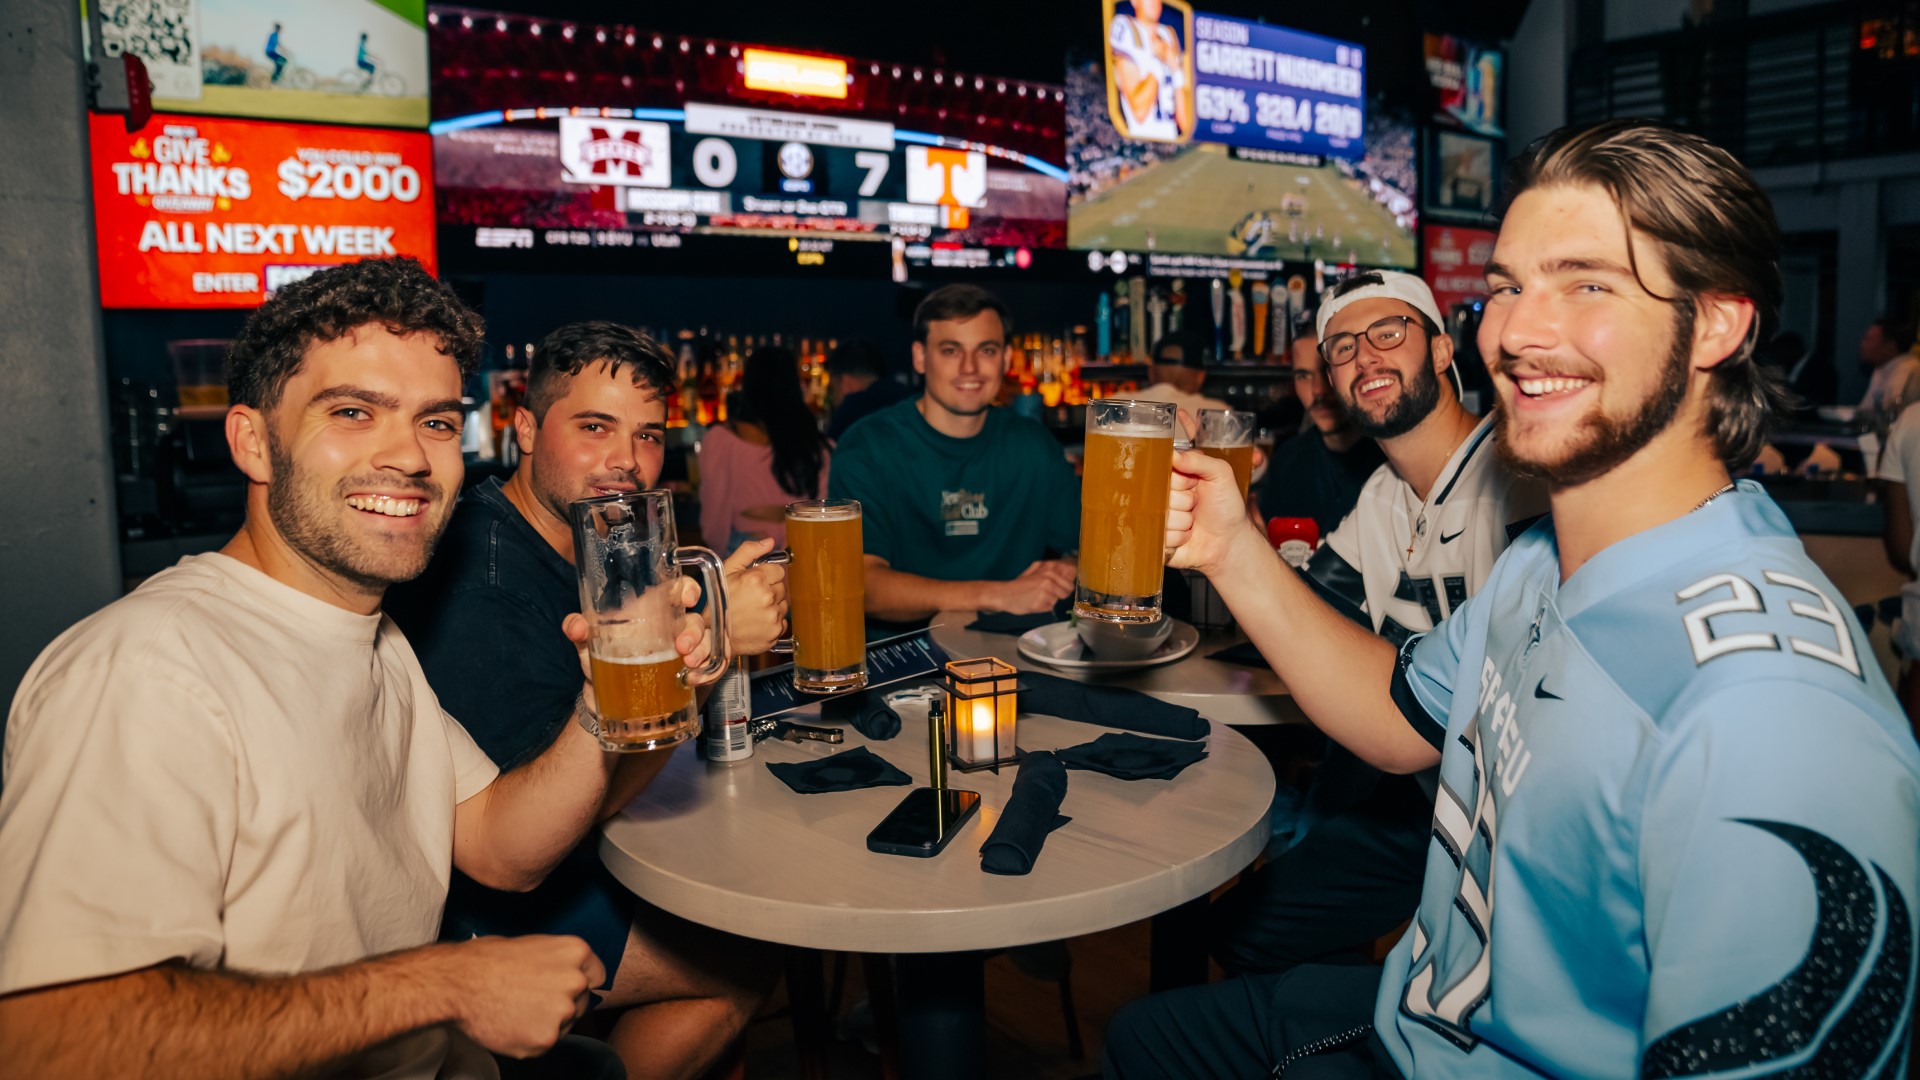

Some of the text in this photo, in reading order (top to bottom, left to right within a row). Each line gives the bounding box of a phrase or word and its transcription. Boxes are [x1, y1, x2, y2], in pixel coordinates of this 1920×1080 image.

[1196, 16, 1249, 46] SEASON
[1196, 39, 1276, 83] GARRETT
[1275, 52, 1362, 98] NUSSMEIER
[1196, 84, 1250, 124] 63%
[153, 135, 211, 165] GIVE
[692, 137, 738, 189] 0
[111, 162, 252, 200] THANKS
[276, 156, 421, 202] $2000
[855, 151, 890, 197] 7
[925, 146, 970, 207] T
[139, 221, 397, 255] ALL NEXT WEEK
[475, 226, 534, 249] ESPN
[192, 272, 259, 292] ENTER
[1675, 569, 1867, 684] 23
